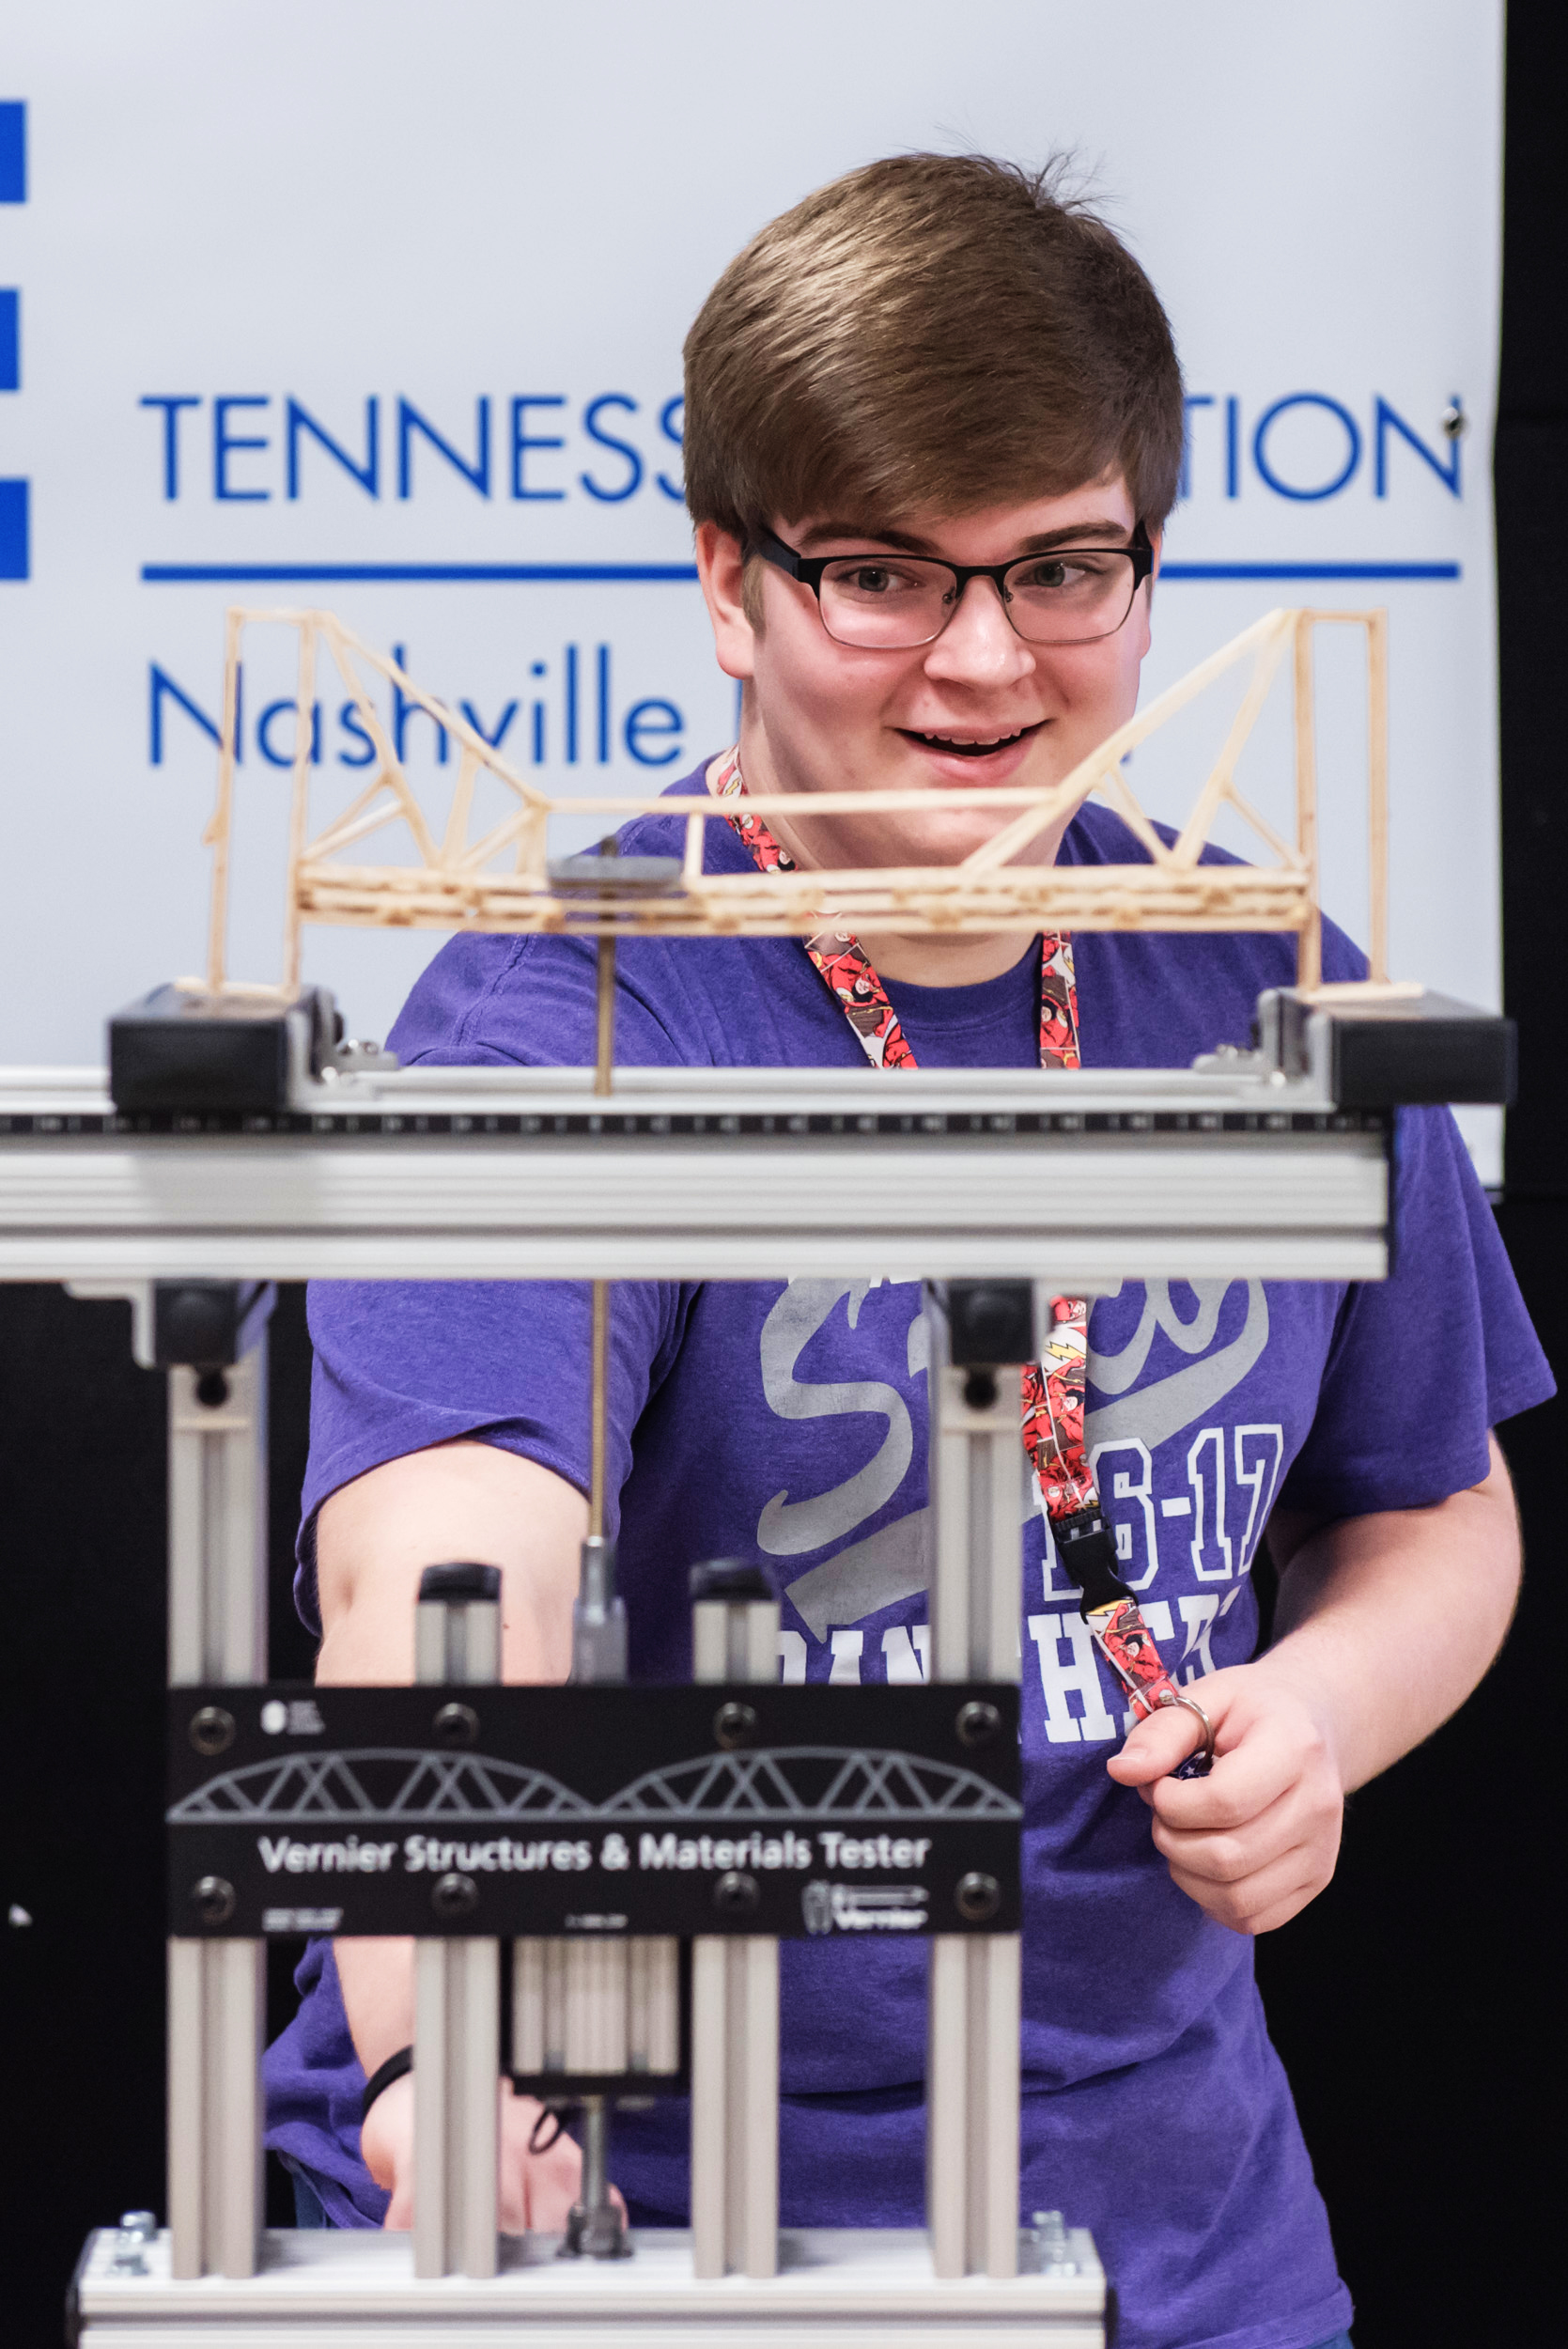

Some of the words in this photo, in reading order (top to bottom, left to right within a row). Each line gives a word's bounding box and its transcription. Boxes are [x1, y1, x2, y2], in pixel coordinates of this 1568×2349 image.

[1176, 392, 1463, 504] TION
[147, 641, 688, 769] Nashville
[256, 1834, 398, 1874] Vernier
[404, 1833, 592, 1873] Structures
[599, 1832, 629, 1871] &
[639, 1829, 812, 1871] Materials
[817, 1830, 932, 1870] Tester
